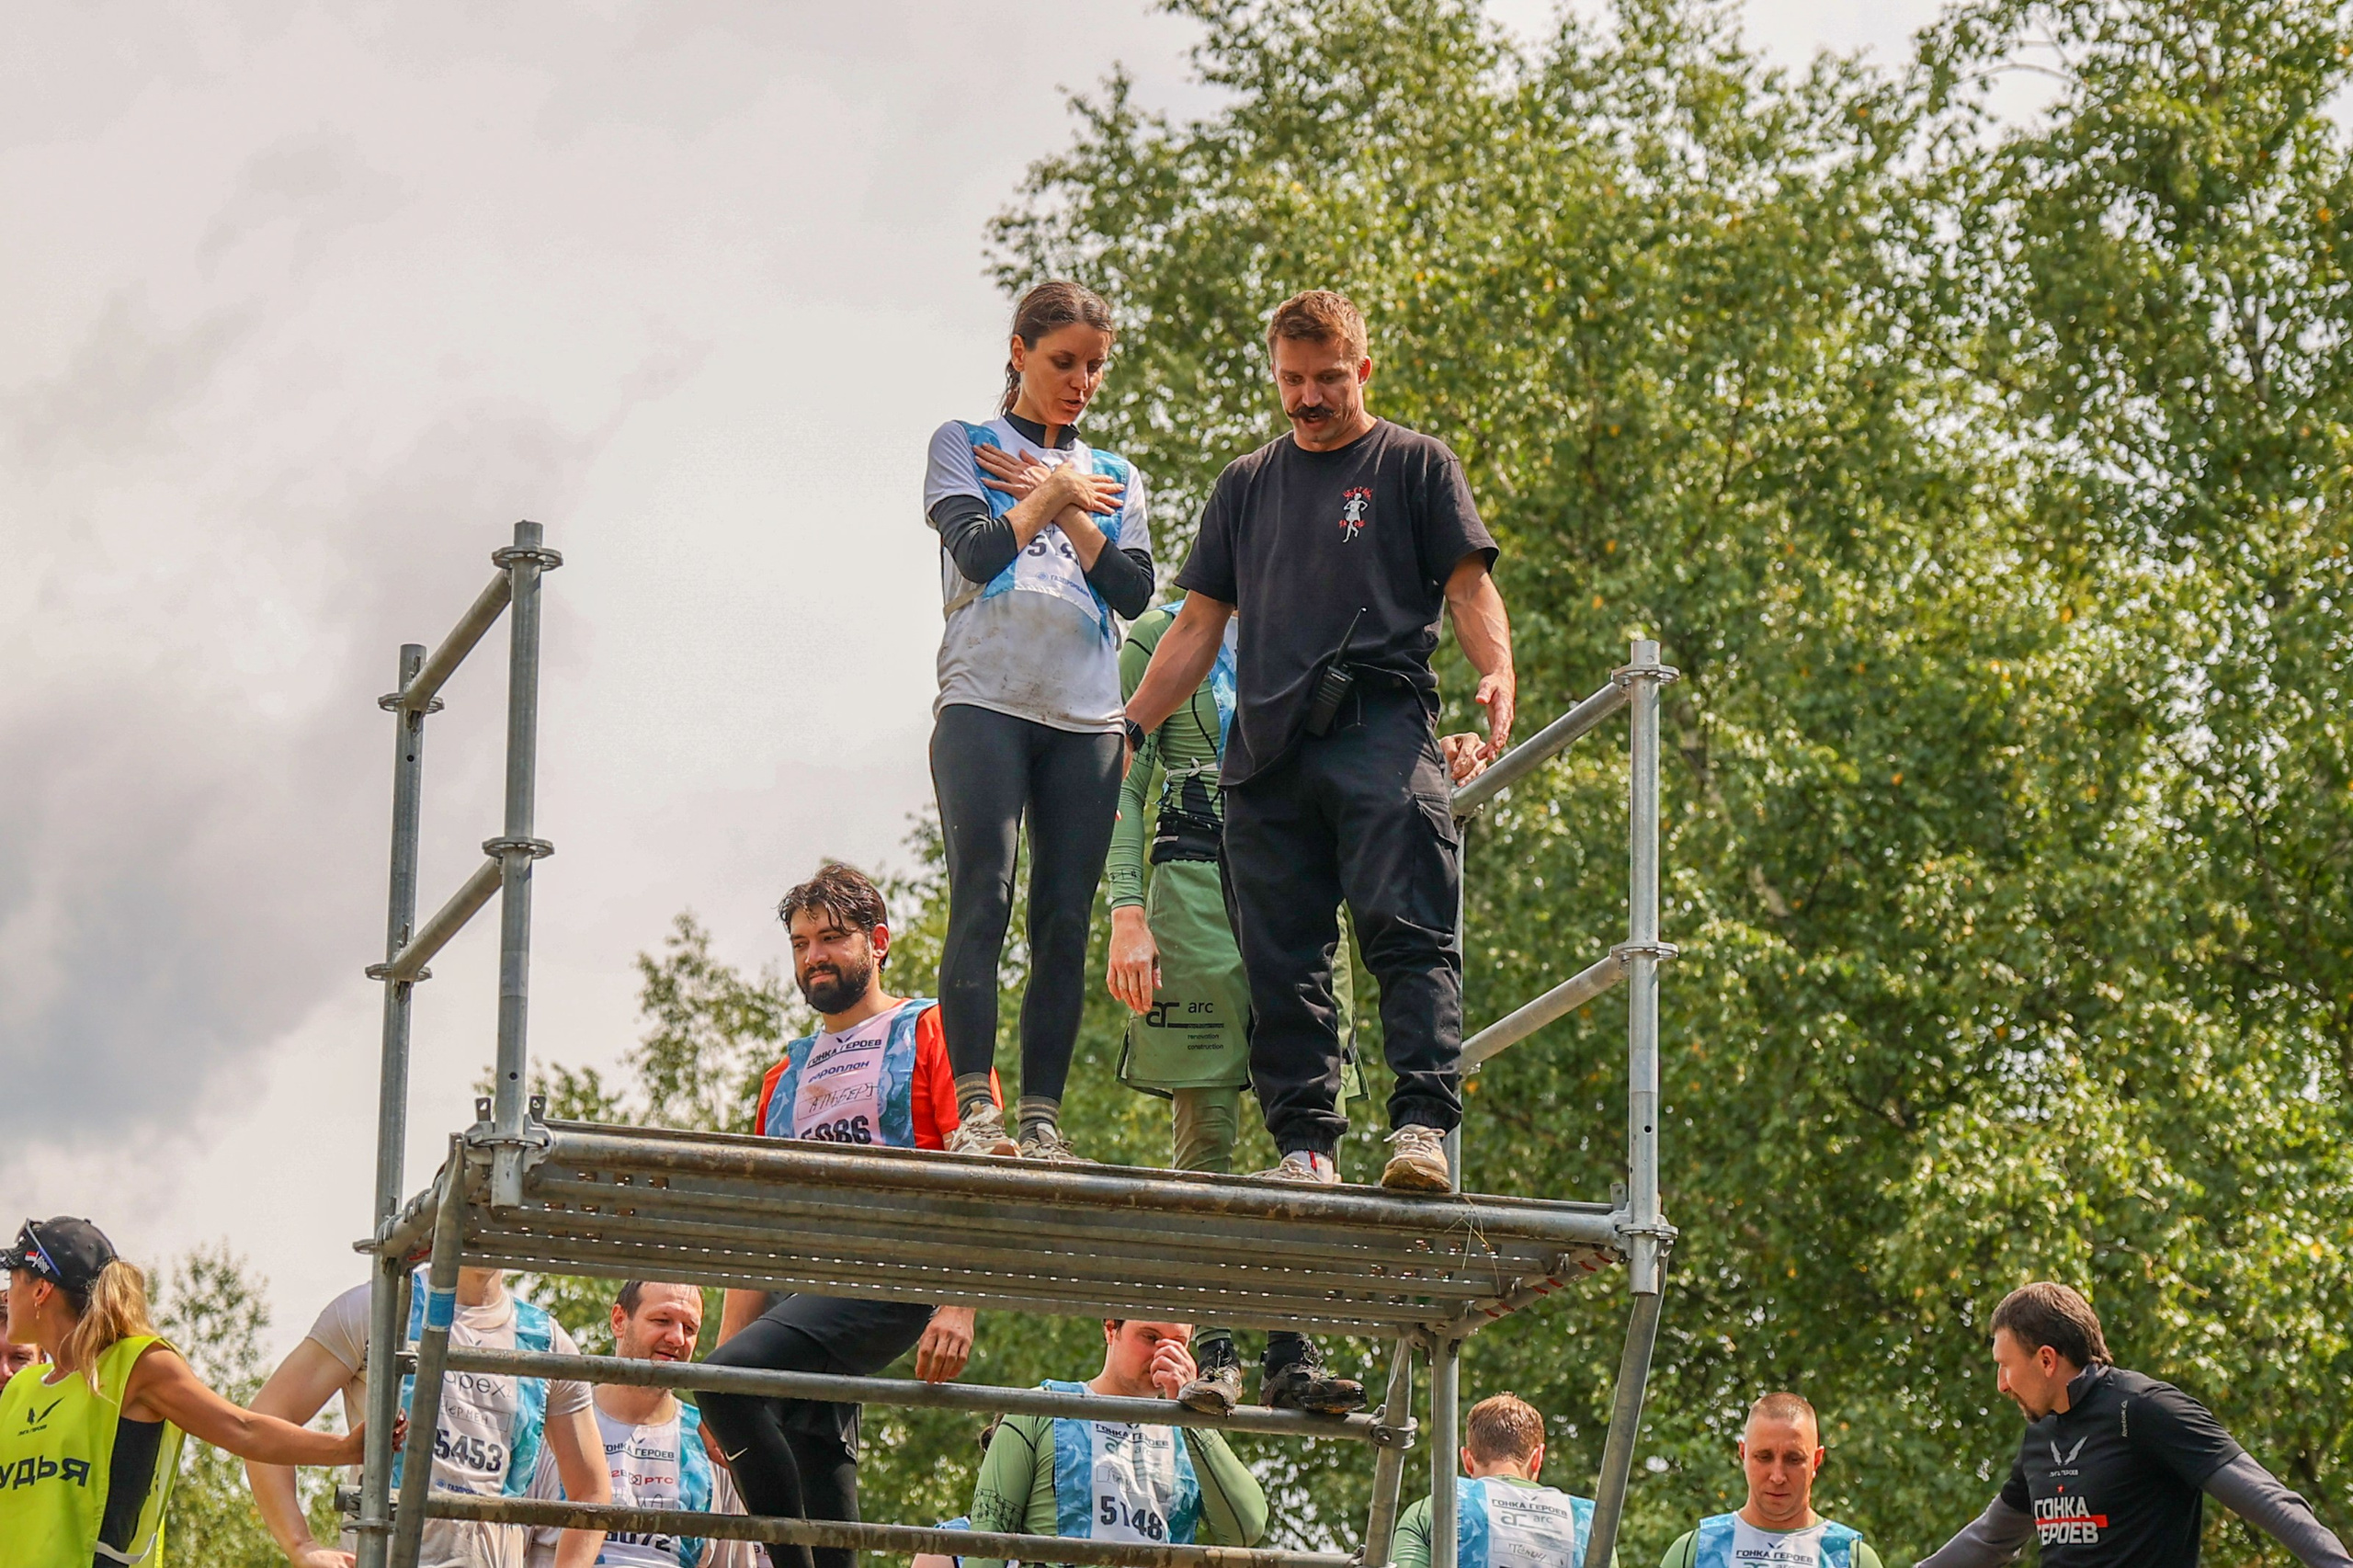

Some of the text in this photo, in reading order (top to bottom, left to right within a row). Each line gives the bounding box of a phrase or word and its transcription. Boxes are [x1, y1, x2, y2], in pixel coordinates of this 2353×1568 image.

[1188, 1002, 1214, 1014] arc
[808, 1040, 882, 1066] ГОНКА ГЕРОЕВ
[1096, 1424, 1129, 1437] ГОНКА
[434, 1428, 503, 1472] 5453
[635, 1448, 675, 1459] ГЕРОЕВ
[0, 1454, 91, 1490] УДЬЯ
[1492, 1499, 1568, 1517] ГОНКА ГЕРОЕВ
[2034, 1496, 2091, 1522] ГОНКА
[1100, 1495, 1163, 1541] 5148
[1533, 1515, 1553, 1525] arc
[1736, 1550, 1813, 1563] ГОНКА ГЕРОЕВ
